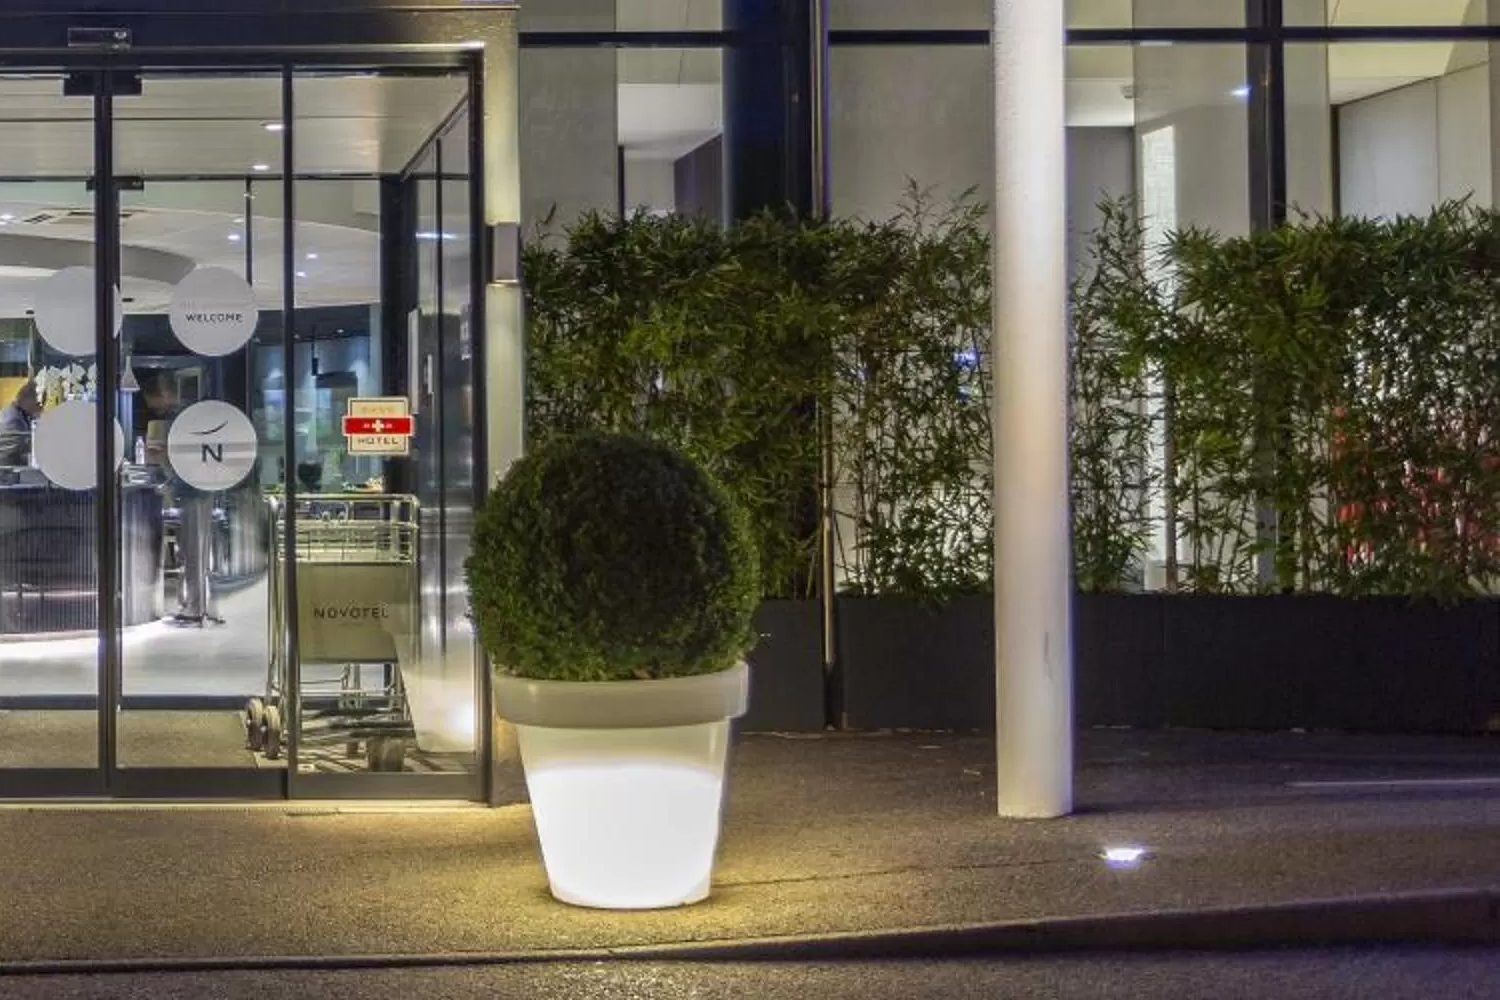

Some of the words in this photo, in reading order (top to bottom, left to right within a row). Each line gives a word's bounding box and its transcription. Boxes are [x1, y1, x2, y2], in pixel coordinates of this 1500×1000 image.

[184, 312, 244, 322] WELCOME
[357, 436, 400, 446] HOTEL
[201, 443, 223, 463] N
[312, 606, 389, 619] NOVOTEL
